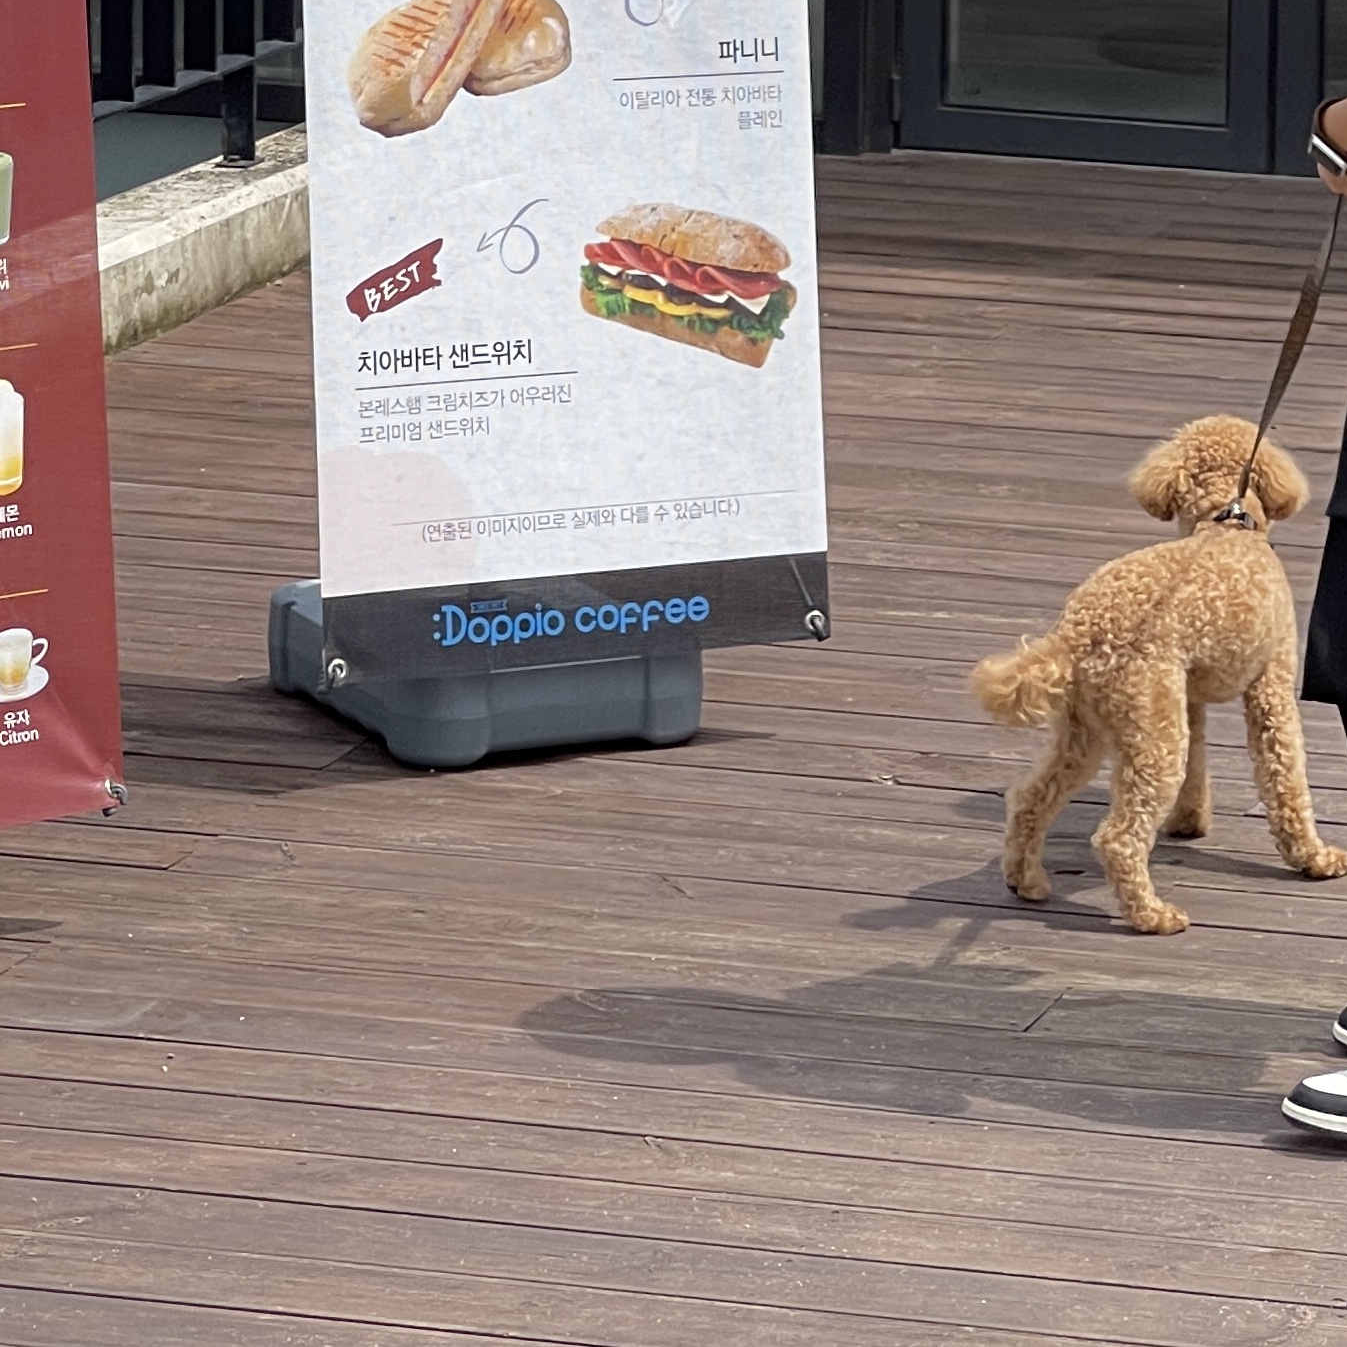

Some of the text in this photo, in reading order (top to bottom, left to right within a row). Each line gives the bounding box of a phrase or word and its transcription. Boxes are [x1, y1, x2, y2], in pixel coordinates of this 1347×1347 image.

[718, 37, 779, 64] 파니니
[619, 84, 782, 110] 이탈리아 전통 치아바타
[737, 109, 783, 130] 플레인
[364, 261, 421, 313] BEST
[358, 338, 533, 376] 치아바타 샌드위치
[426, 388, 506, 412] 크림치즈가
[510, 384, 572, 406] 어우러진
[359, 416, 490, 444] 프리미엄 샌드위치
[476, 512, 567, 538] 이미지이므로
[571, 508, 617, 530] 실제와
[620, 506, 650, 525] 다를
[653, 504, 669, 523] 수
[574, 595, 711, 635] coffee
[3, 708, 30, 729] 유자
[0, 728, 39, 746] Citron
